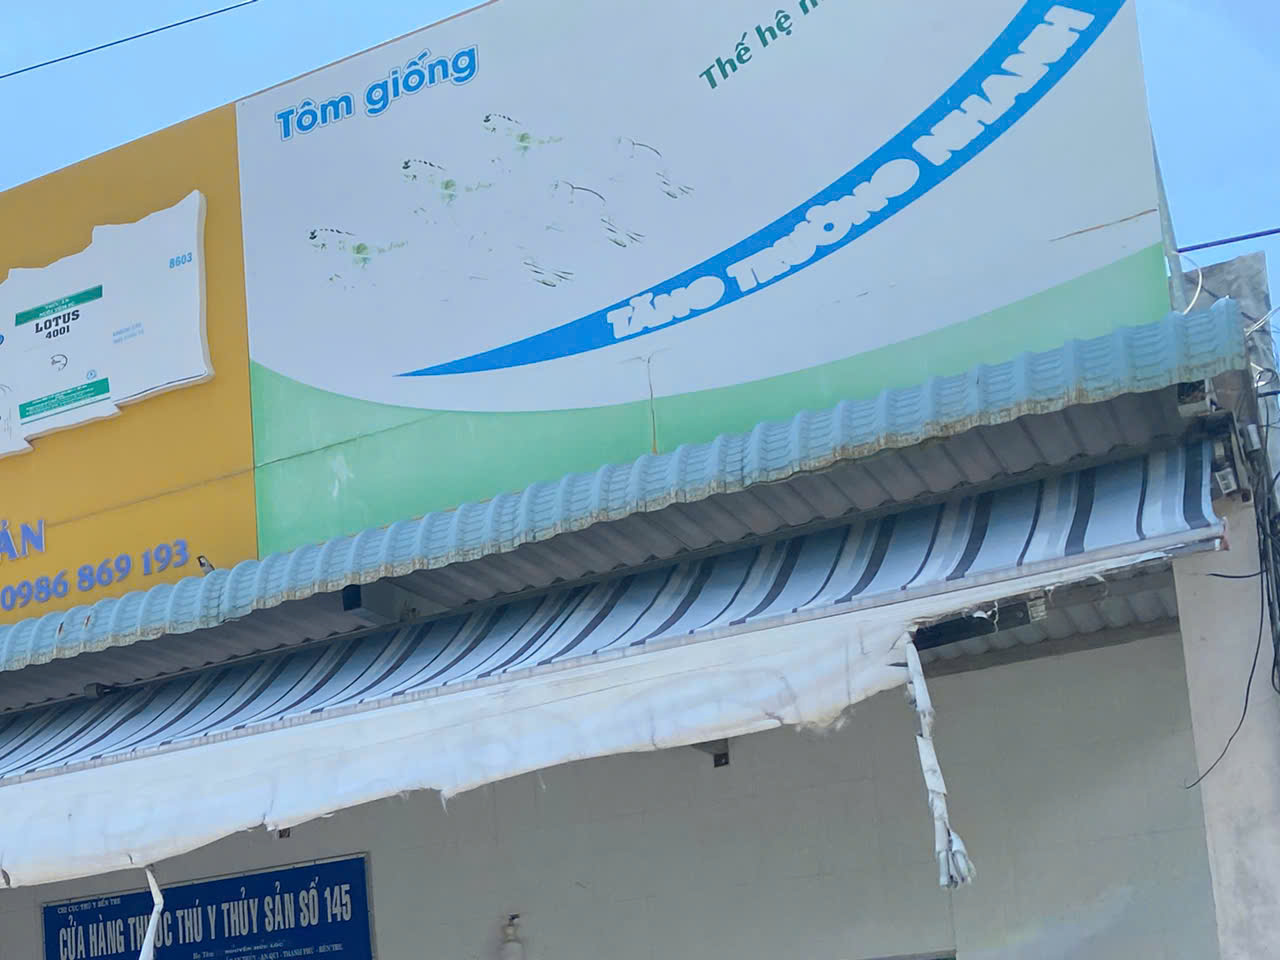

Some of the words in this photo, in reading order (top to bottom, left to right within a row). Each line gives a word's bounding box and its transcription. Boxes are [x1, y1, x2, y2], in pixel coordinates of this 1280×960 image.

[699, 31, 752, 90] Thế
[755, 9, 792, 48] hệ
[275, 93, 354, 141] Tôm
[365, 46, 477, 116] giống
[169, 252, 192, 269] 8603
[35, 310, 80, 334] LOTUS
[0, 568, 68, 612] 0986
[77, 553, 132, 592] 869
[140, 538, 190, 577] 193
[60, 915, 85, 960] CỬA
[89, 914, 125, 957] HÀNG
[176, 899, 203, 944] THÚ
[207, 905, 217, 940] Y
[222, 887, 259, 938] THỦY
[264, 881, 295, 932] SẢN
[300, 876, 319, 927] SỐ
[324, 884, 352, 923] 145
